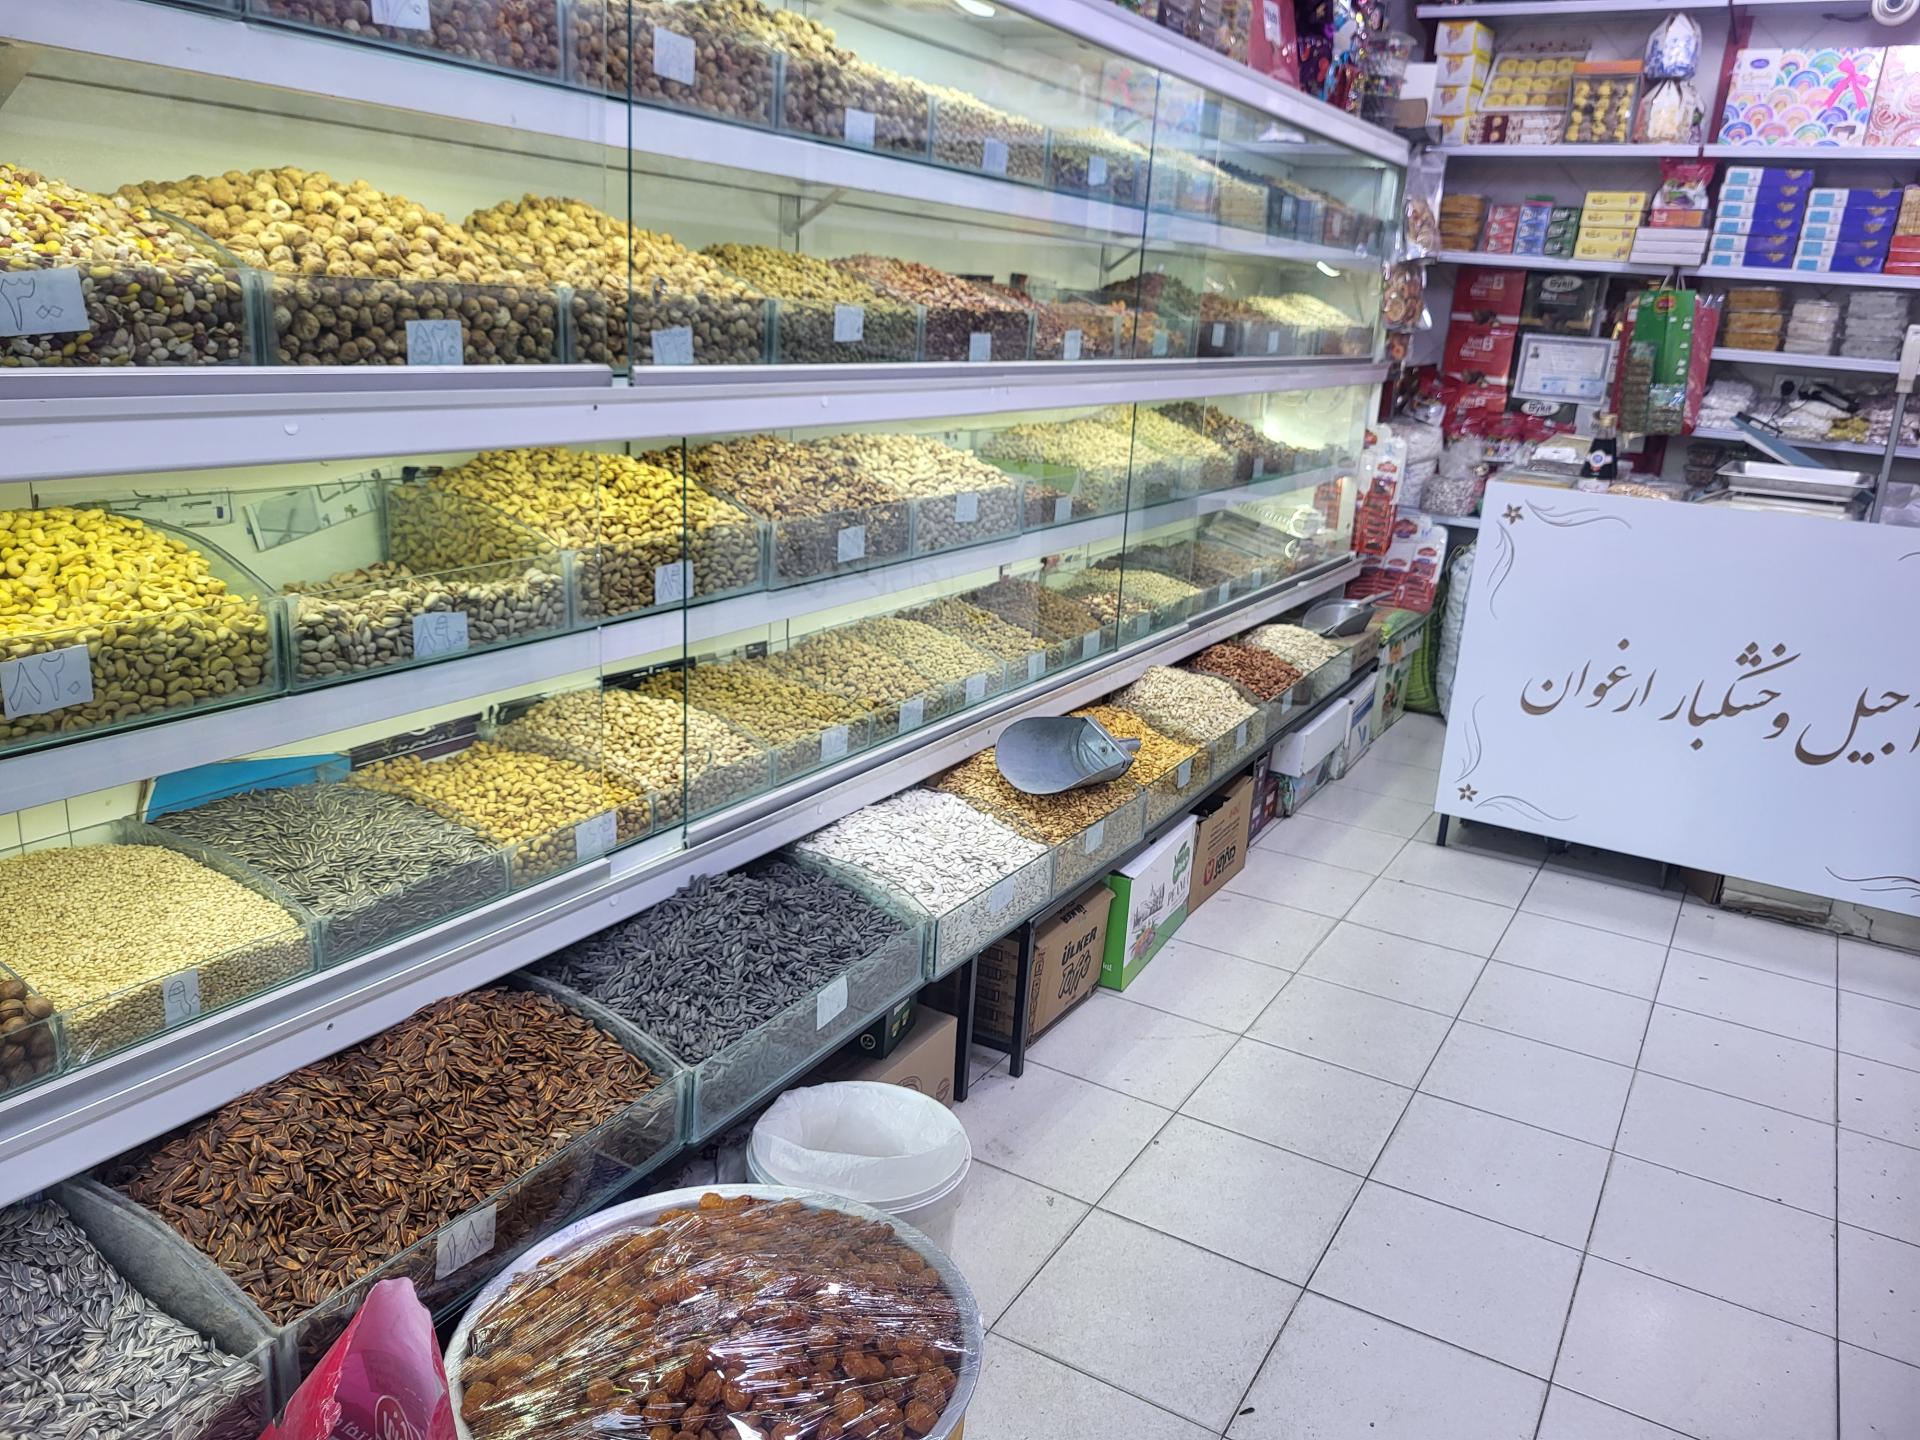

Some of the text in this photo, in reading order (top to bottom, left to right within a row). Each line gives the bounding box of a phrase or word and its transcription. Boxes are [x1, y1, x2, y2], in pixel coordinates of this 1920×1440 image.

[9, 652, 81, 712] ۸۲۰
[1520, 638, 1657, 716] ارغوان
[1657, 641, 1801, 751] خشکبار
[1762, 712, 1790, 740] و
[1061, 925, 1098, 967] ÜLKER
